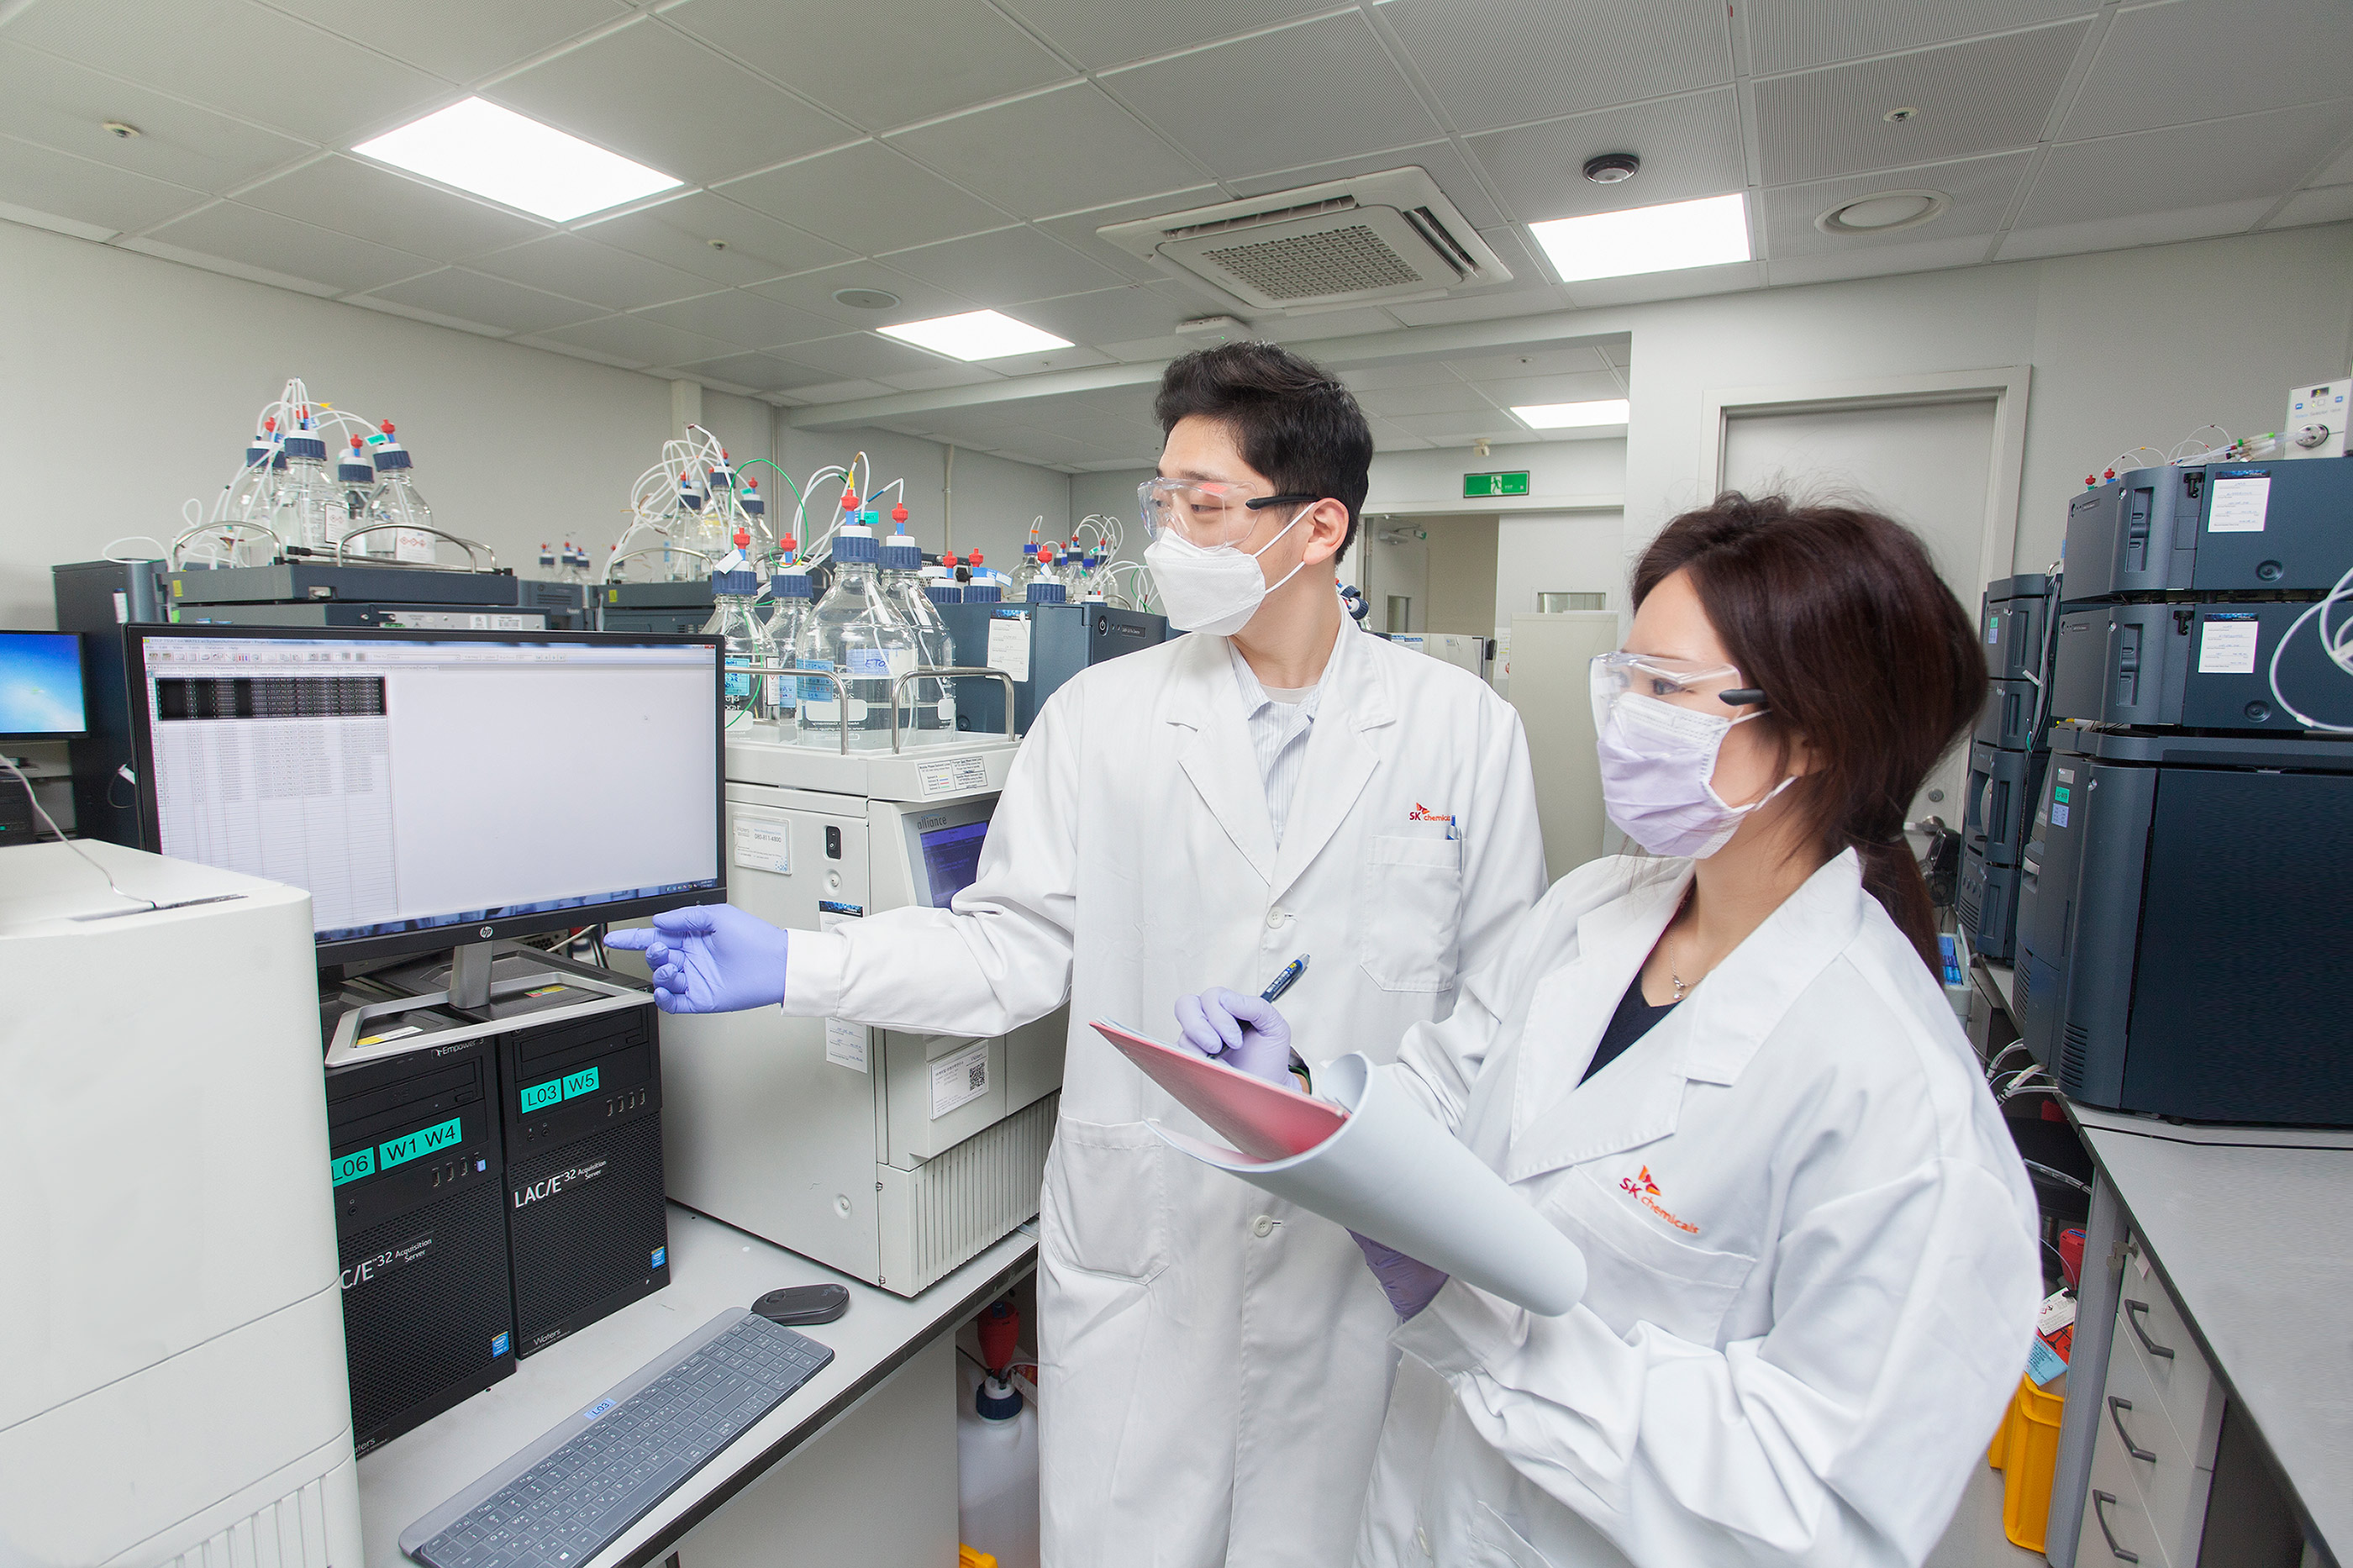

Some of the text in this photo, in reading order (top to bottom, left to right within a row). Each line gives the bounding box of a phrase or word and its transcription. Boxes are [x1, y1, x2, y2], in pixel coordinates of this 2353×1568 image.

[918, 816, 947, 830] alliance
[1409, 812, 1421, 821] SK
[442, 1039, 476, 1055] Empower
[527, 1072, 595, 1107] L03 W5
[331, 1124, 455, 1181] L06 W1 W4
[577, 1160, 607, 1176] Acquisition
[584, 1169, 603, 1181] Server
[1619, 1177, 1700, 1234] SK chemicals
[395, 1239, 433, 1258] Acquisition
[404, 1250, 426, 1263] Server
[533, 1329, 561, 1345] Waters
[592, 1402, 610, 1415] L03
